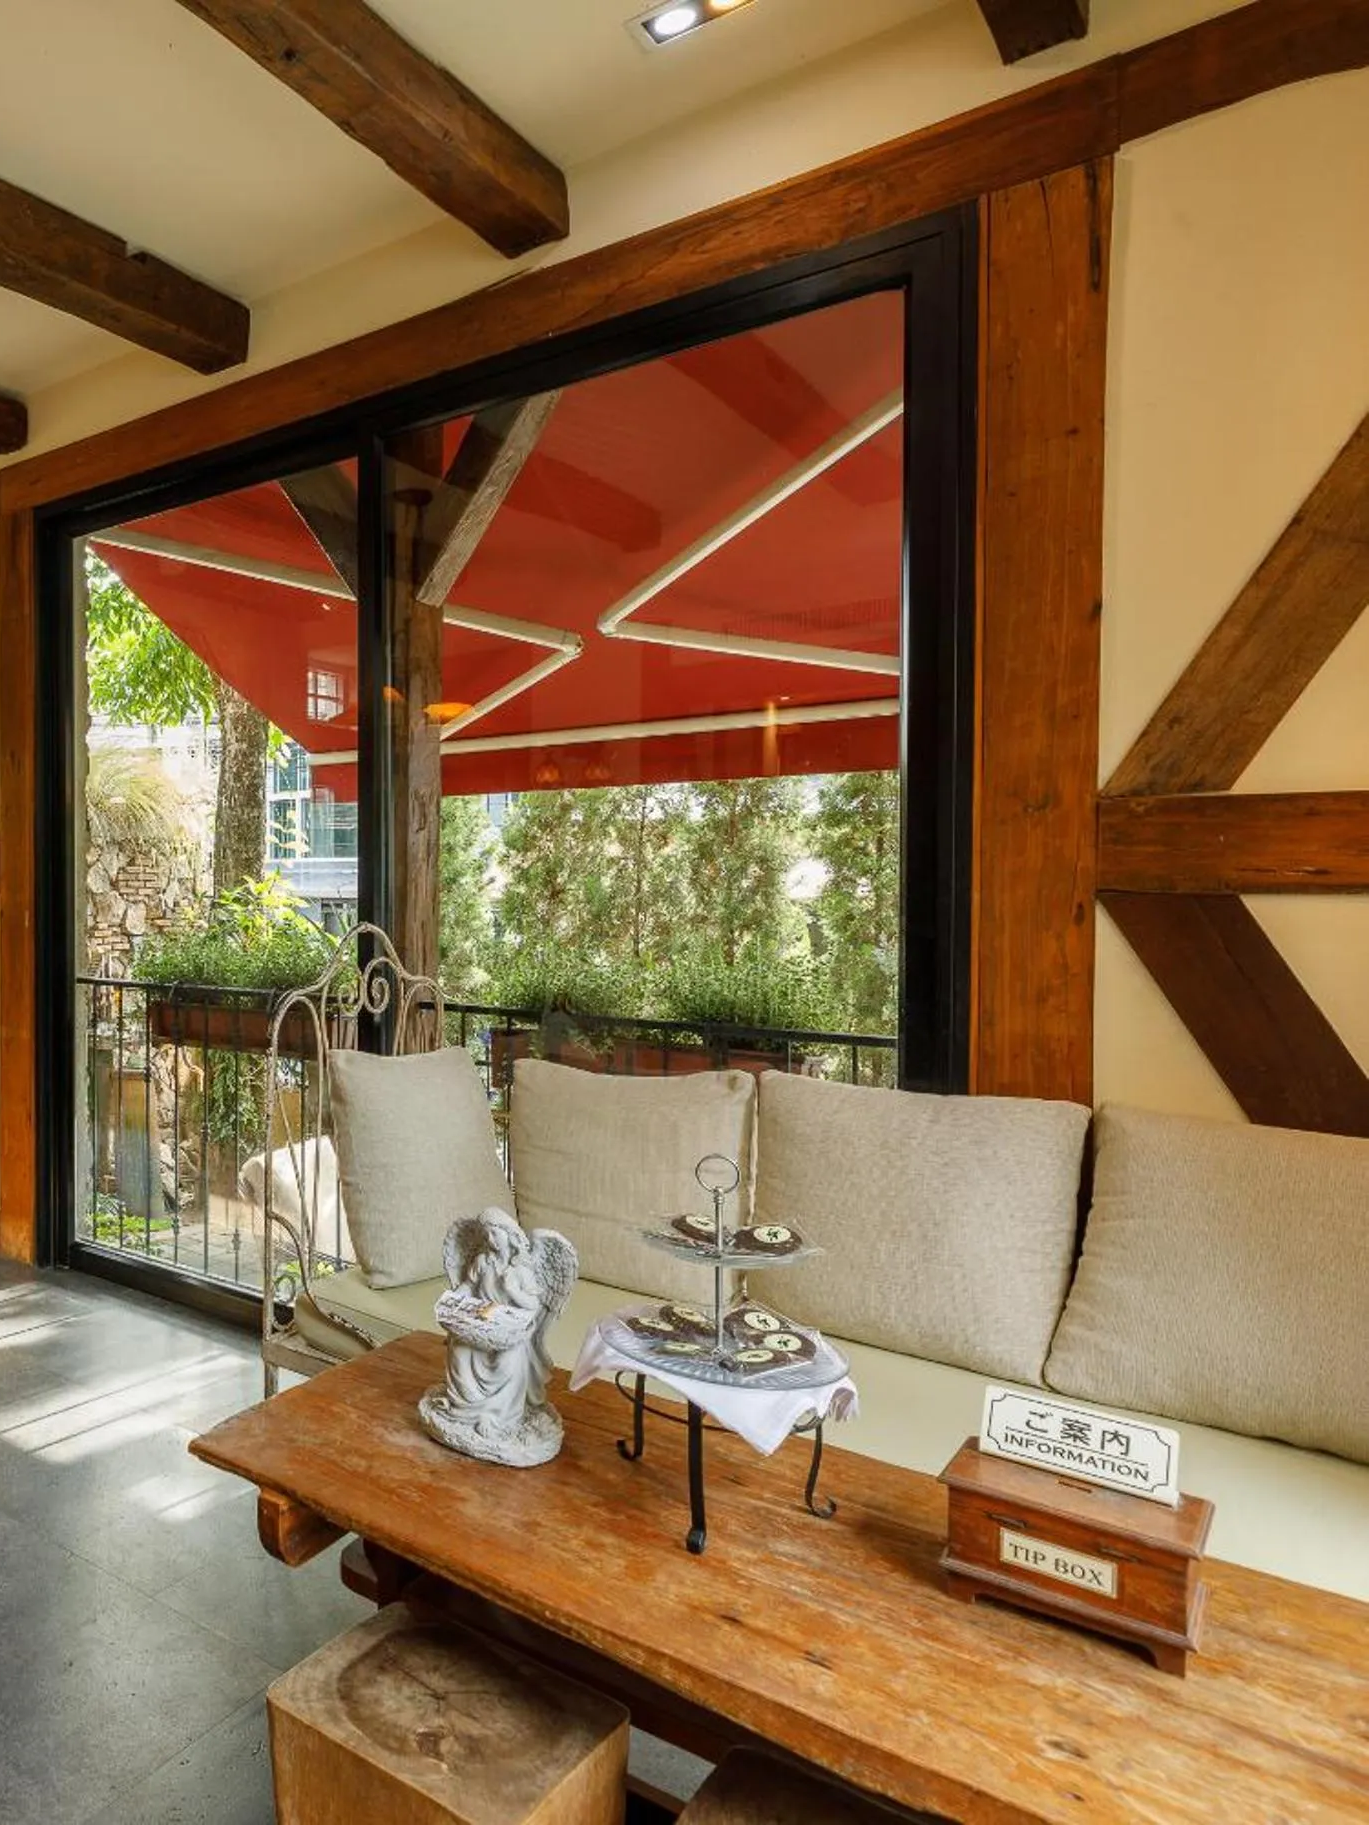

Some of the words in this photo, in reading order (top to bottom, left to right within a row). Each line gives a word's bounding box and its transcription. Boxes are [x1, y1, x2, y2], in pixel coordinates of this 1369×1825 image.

[1025, 1410, 1131, 1456] ご案内
[1003, 1432, 1150, 1481] INFORMATION
[1009, 1542, 1046, 1565] TIP
[1054, 1557, 1104, 1587] BOX
